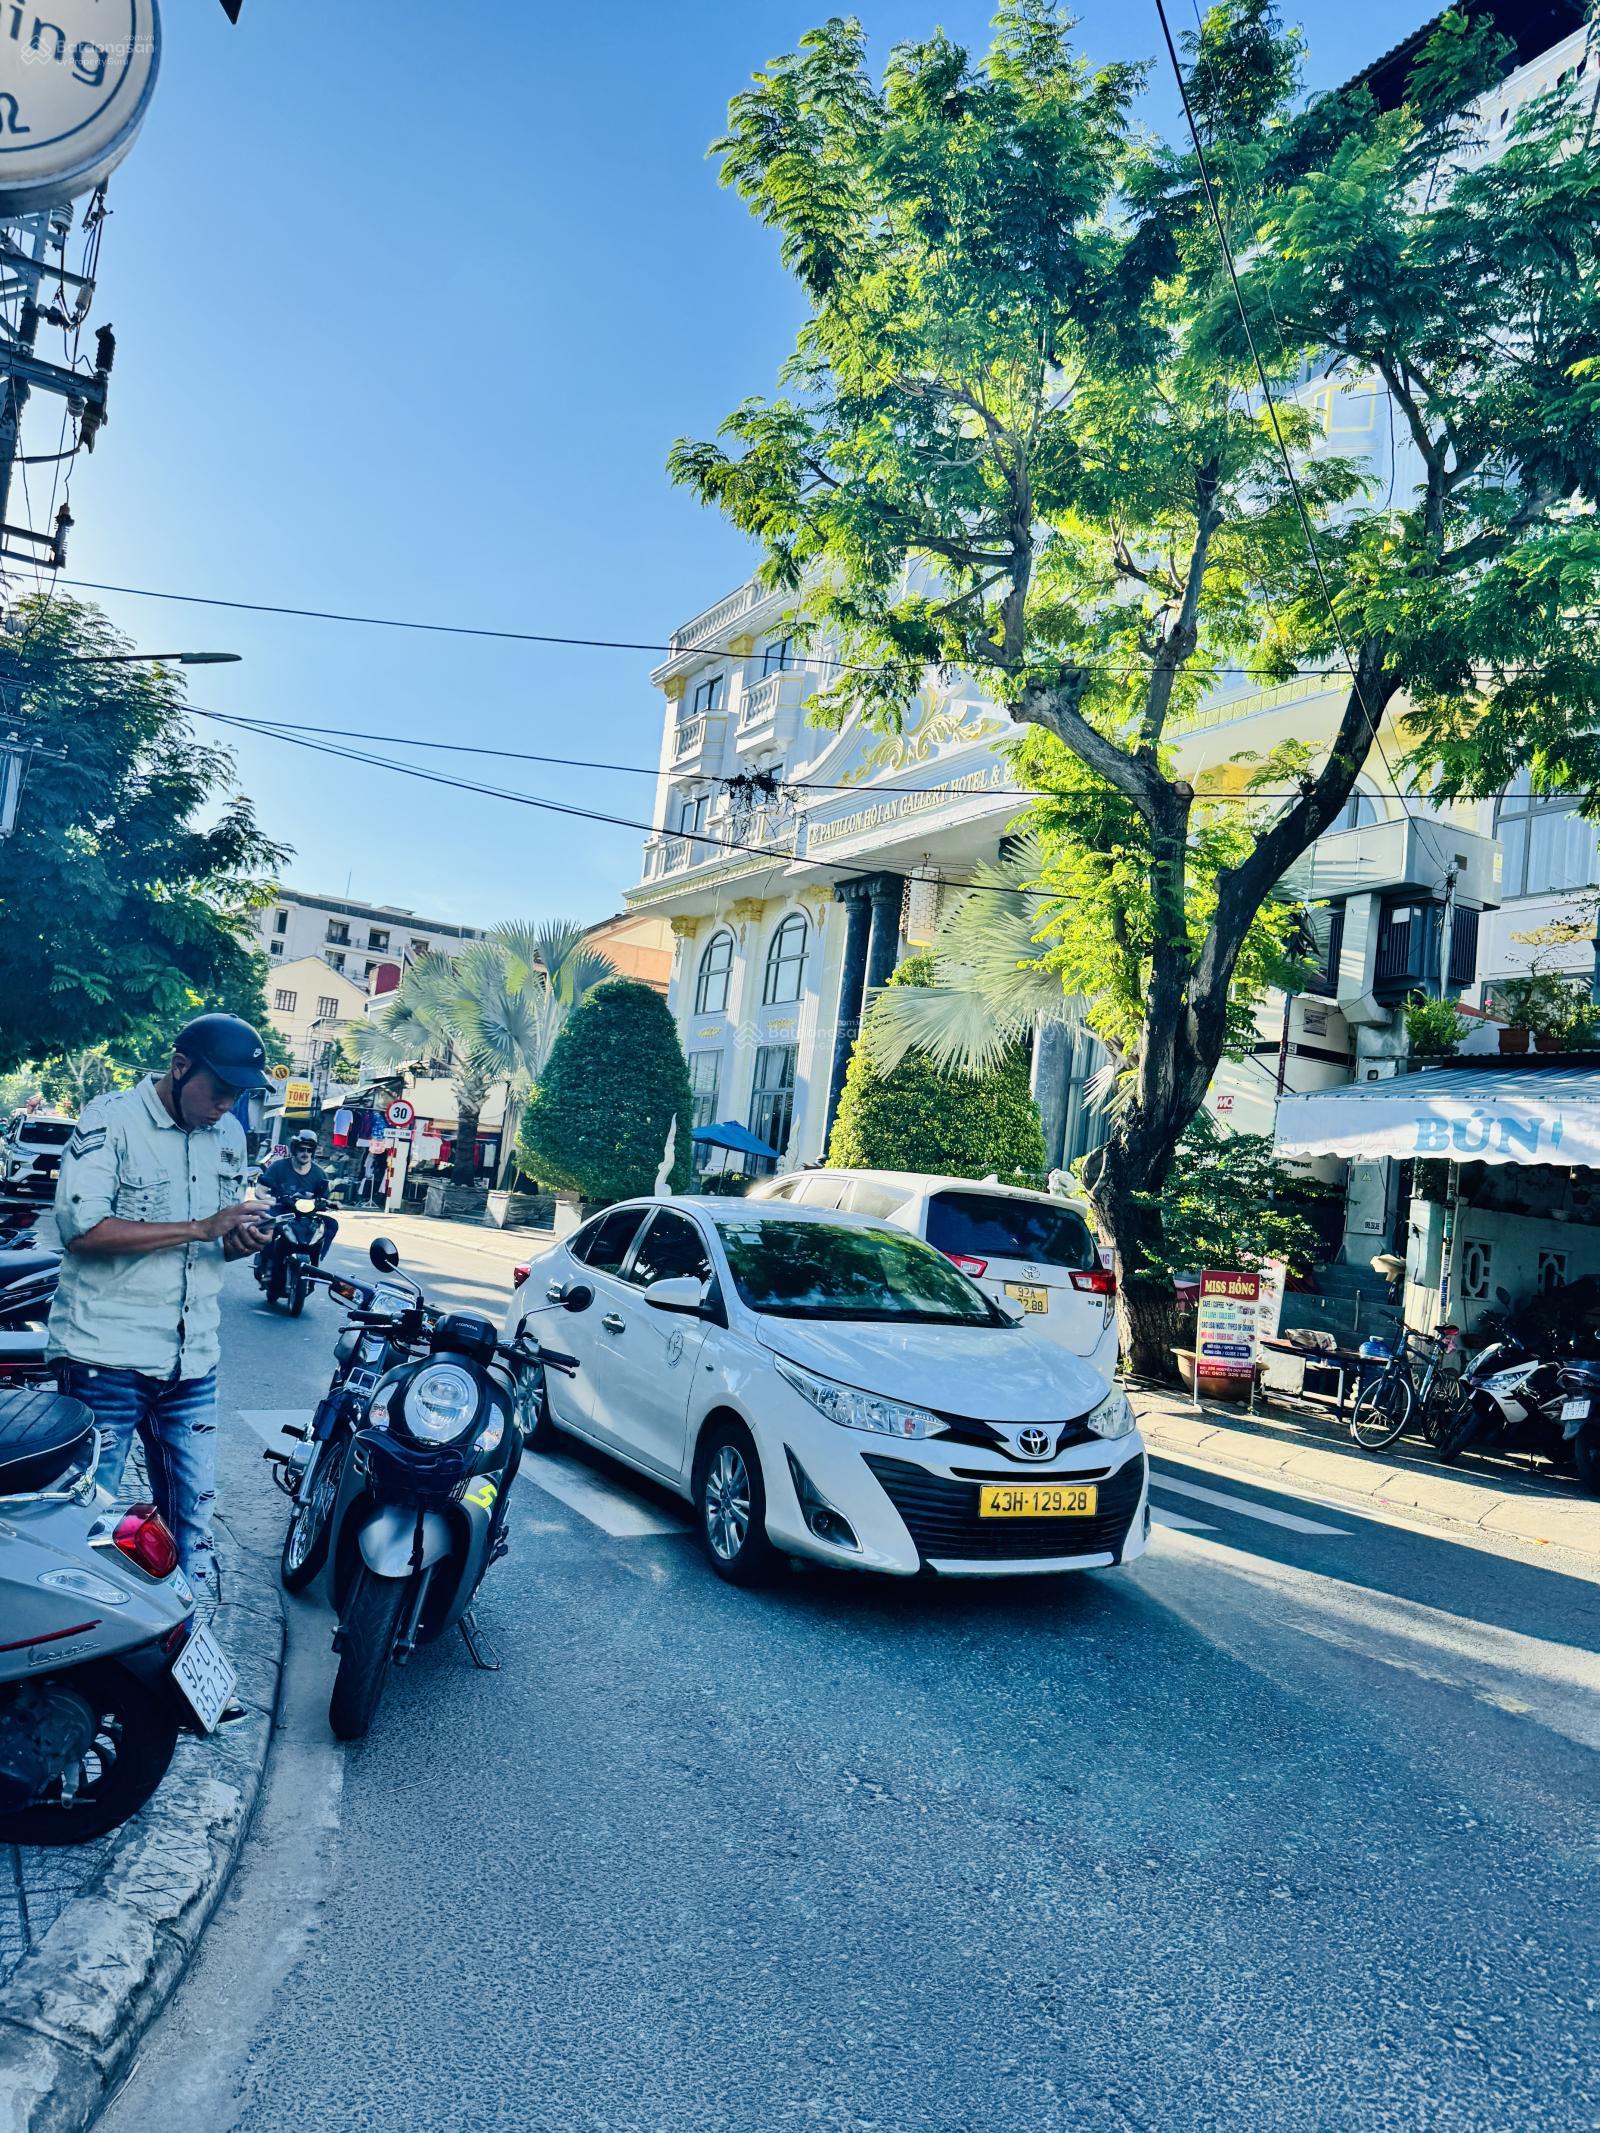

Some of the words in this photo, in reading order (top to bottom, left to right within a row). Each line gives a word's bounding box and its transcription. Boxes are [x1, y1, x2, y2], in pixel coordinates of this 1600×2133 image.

[0, 0, 108, 87] ing
[820, 811, 863, 842] PAVILLON
[900, 782, 949, 814] GALLERY
[951, 768, 989, 799] HOTEL
[393, 1106, 407, 1120] 30
[1413, 1108, 1545, 1154] BÚN
[1204, 1279, 1227, 1294] MISS
[990, 1491, 1088, 1512] 43H-129.28
